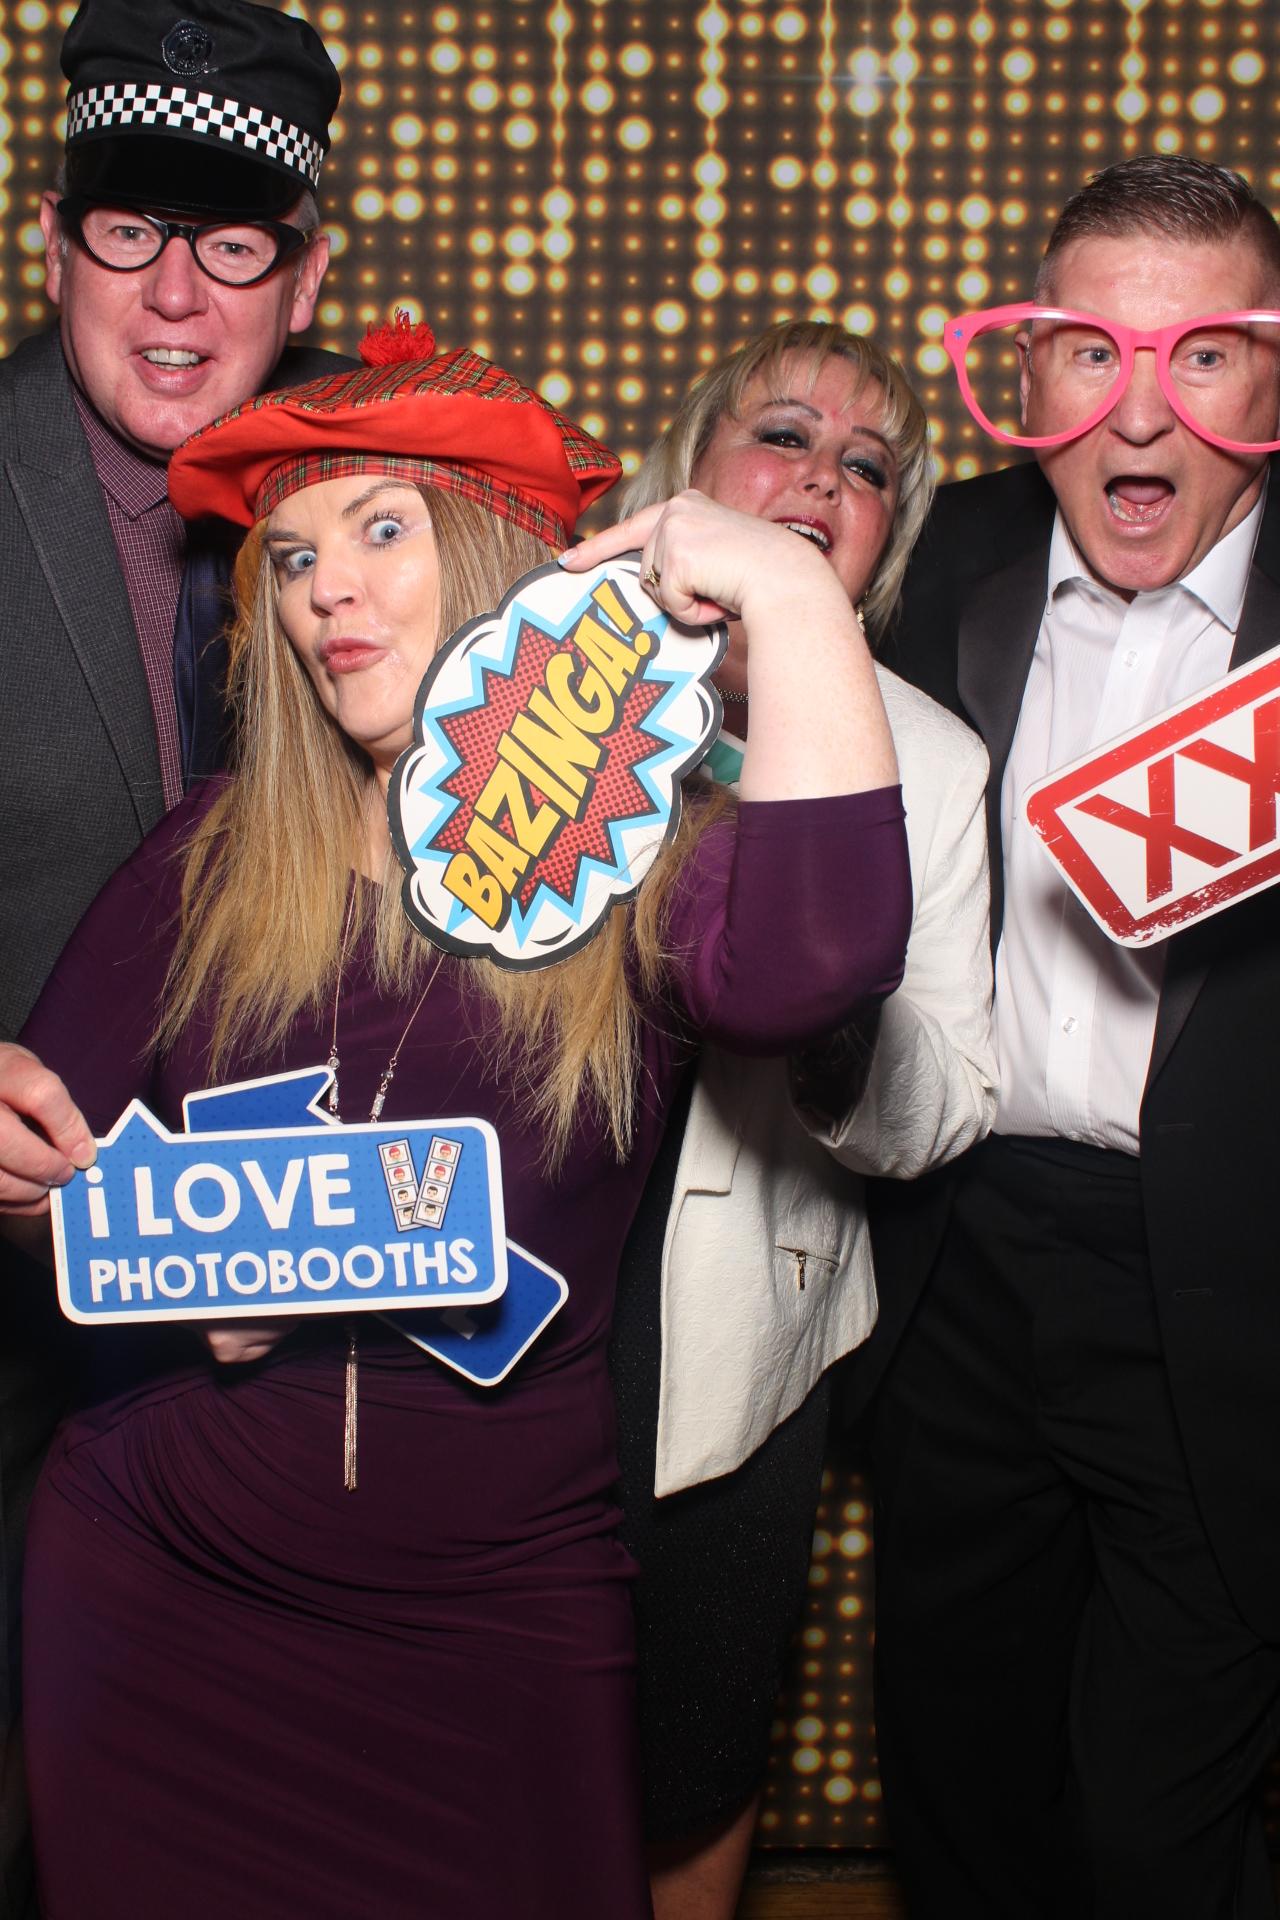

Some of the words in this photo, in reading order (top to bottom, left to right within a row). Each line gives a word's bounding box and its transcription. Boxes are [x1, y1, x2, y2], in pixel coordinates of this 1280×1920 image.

[442, 578, 660, 932] BAZINGA!
[86, 1166, 110, 1238] i
[134, 1153, 356, 1236] LOVE
[89, 1238, 478, 1303] PHOTOBOOTHS
